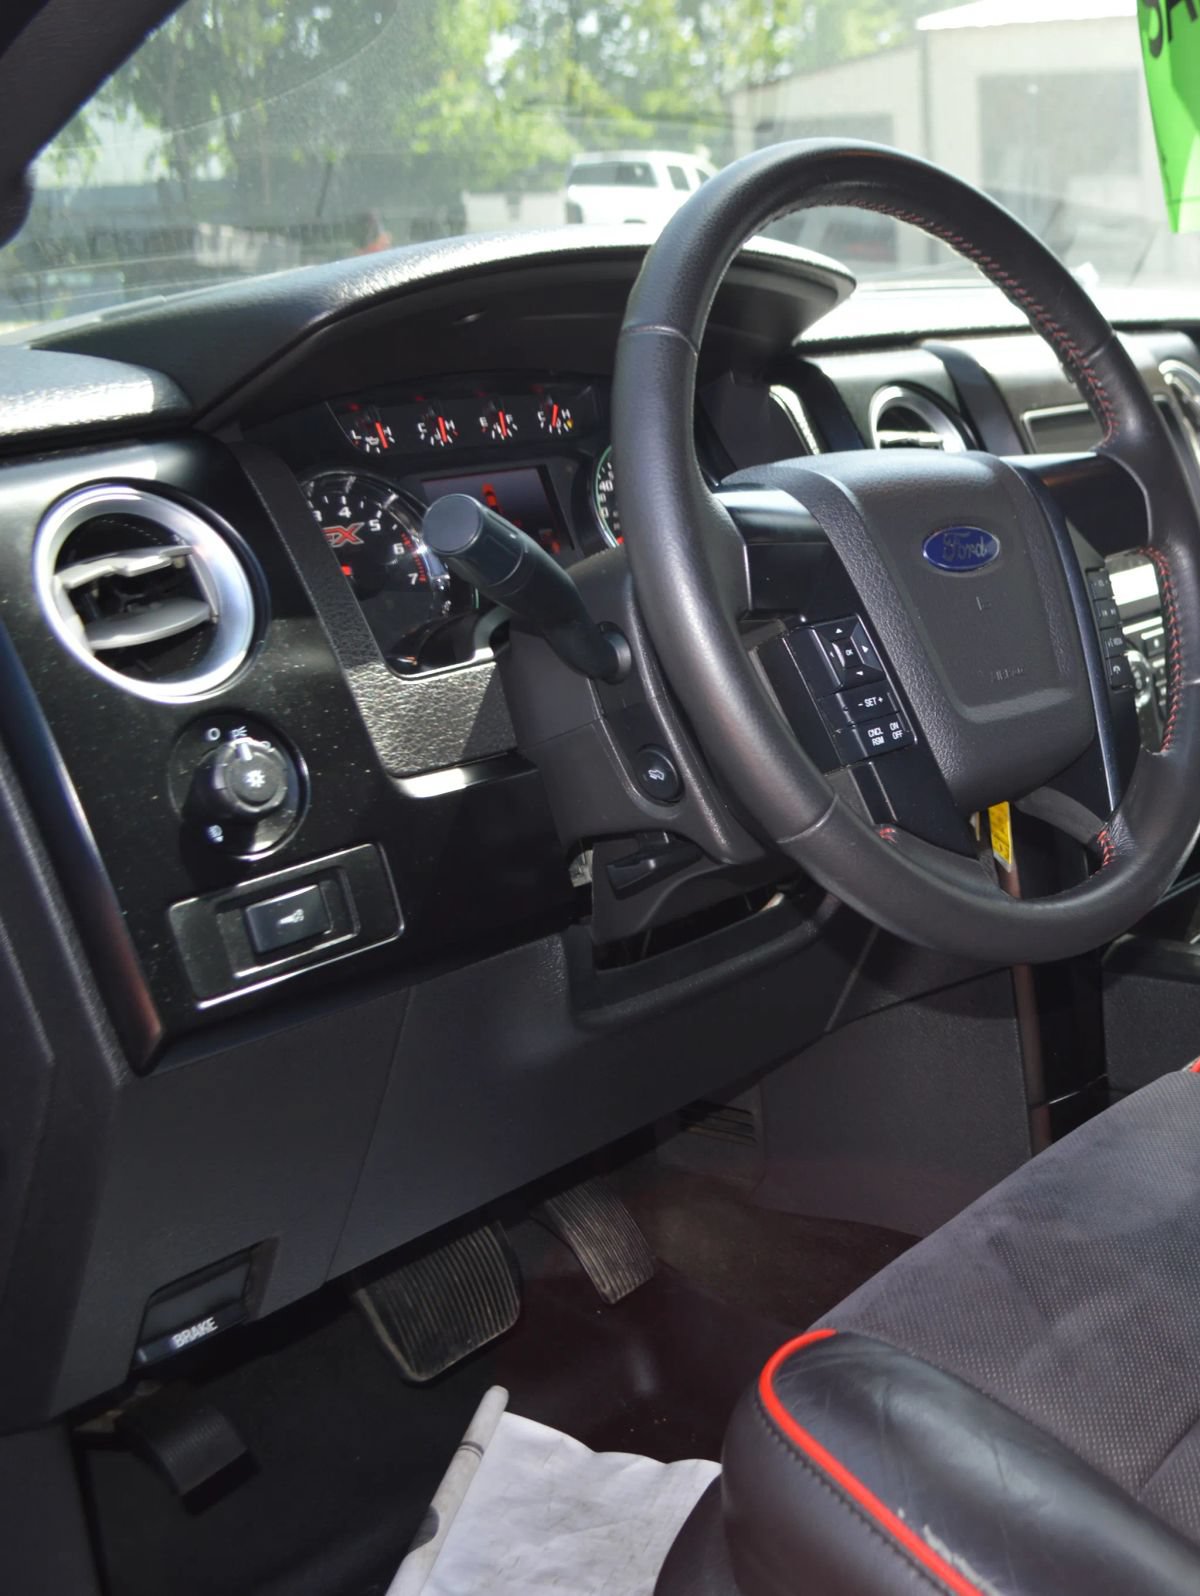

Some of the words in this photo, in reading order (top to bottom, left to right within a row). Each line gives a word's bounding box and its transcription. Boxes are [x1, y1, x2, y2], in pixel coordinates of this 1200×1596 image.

[350, 429, 362, 440] L
[338, 506, 352, 518] 4
[369, 519, 381, 531] 5
[393, 543, 405, 555] 6
[943, 531, 987, 561] Ford
[408, 573, 419, 585] 7
[864, 697, 877, 707] SET
[867, 727, 884, 738] CNCL
[889, 722, 899, 731] ON
[892, 730, 903, 740] OFF
[171, 1316, 218, 1349] BRAKE
